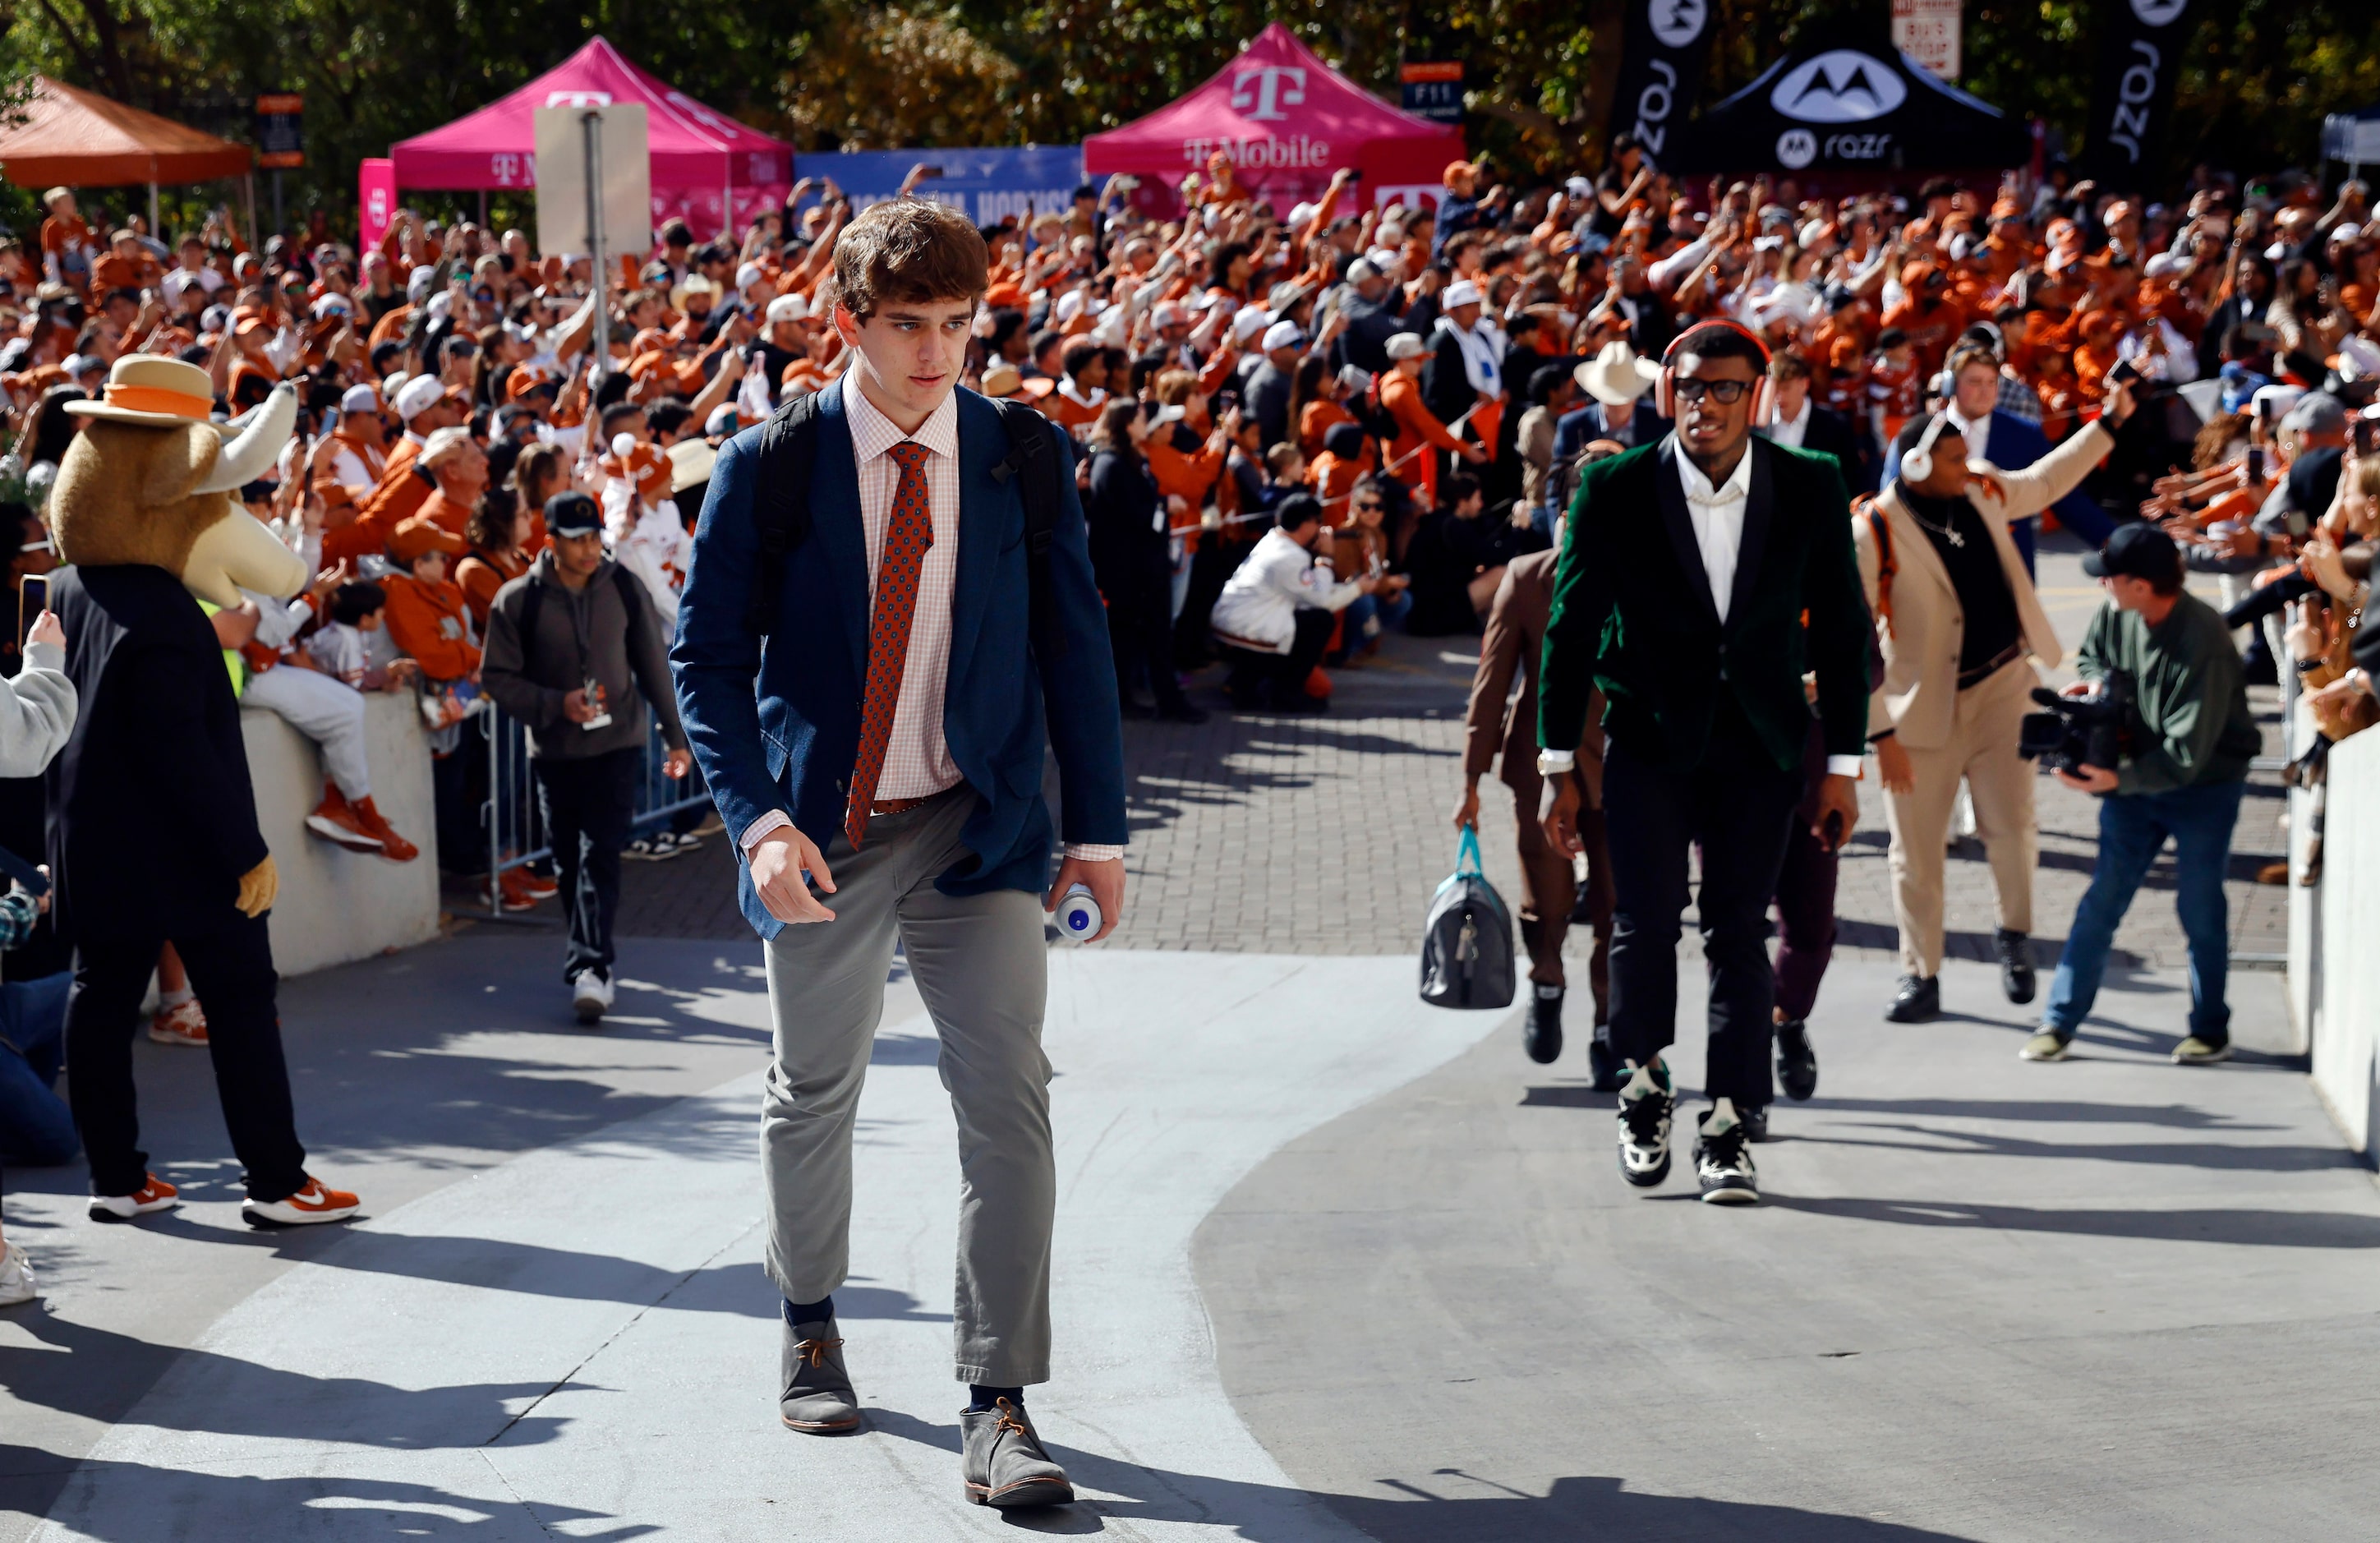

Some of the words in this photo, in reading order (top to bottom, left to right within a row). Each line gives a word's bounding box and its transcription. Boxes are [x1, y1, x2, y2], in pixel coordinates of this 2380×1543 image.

[1905, 21, 1945, 38] BUS
[1232, 66, 1306, 121] T
[1415, 83, 1450, 104] F11
[2108, 39, 2161, 164] razr
[1825, 133, 1892, 159] razr
